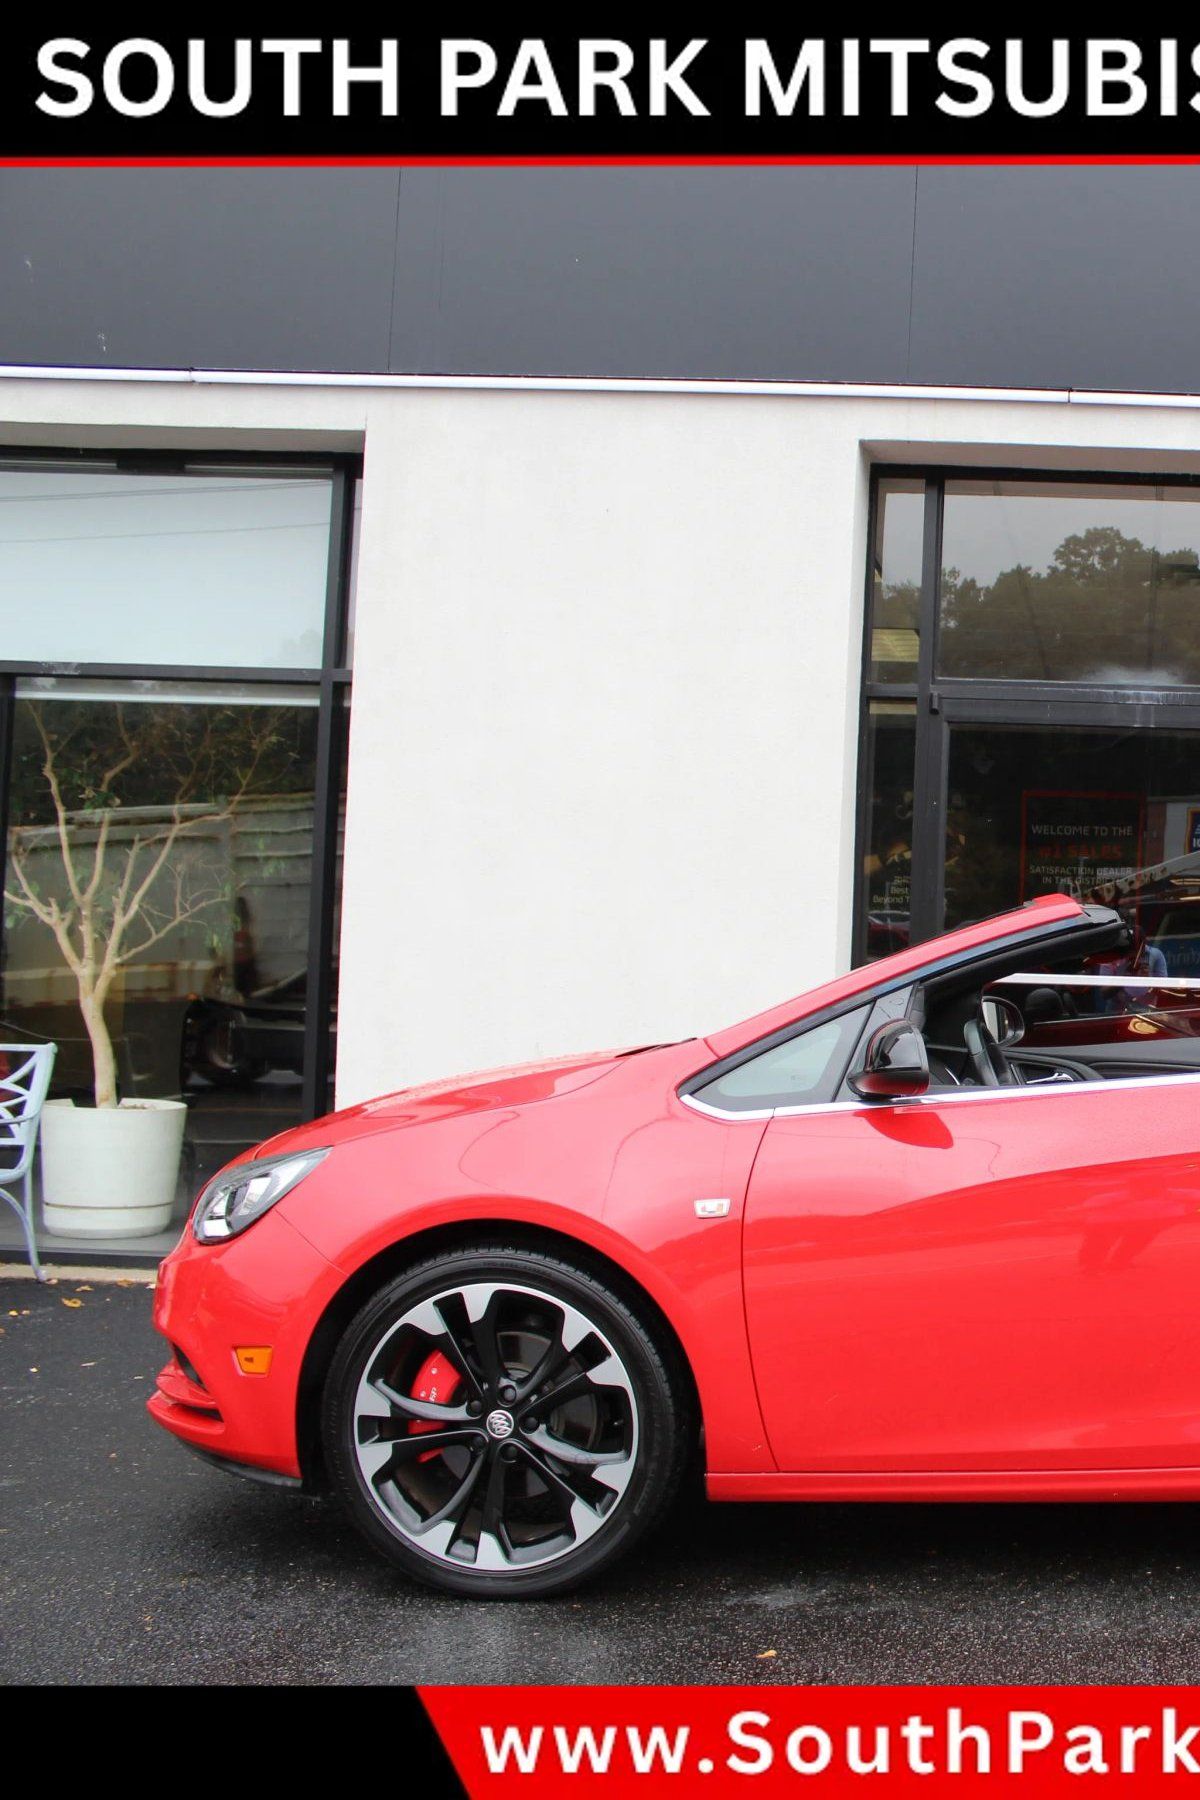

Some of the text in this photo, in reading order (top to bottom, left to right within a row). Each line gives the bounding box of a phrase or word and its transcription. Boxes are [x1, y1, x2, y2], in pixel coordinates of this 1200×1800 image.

[1032, 825, 1133, 836] WELCOME TO THE
[1029, 866, 1094, 876] SATISFACTION
